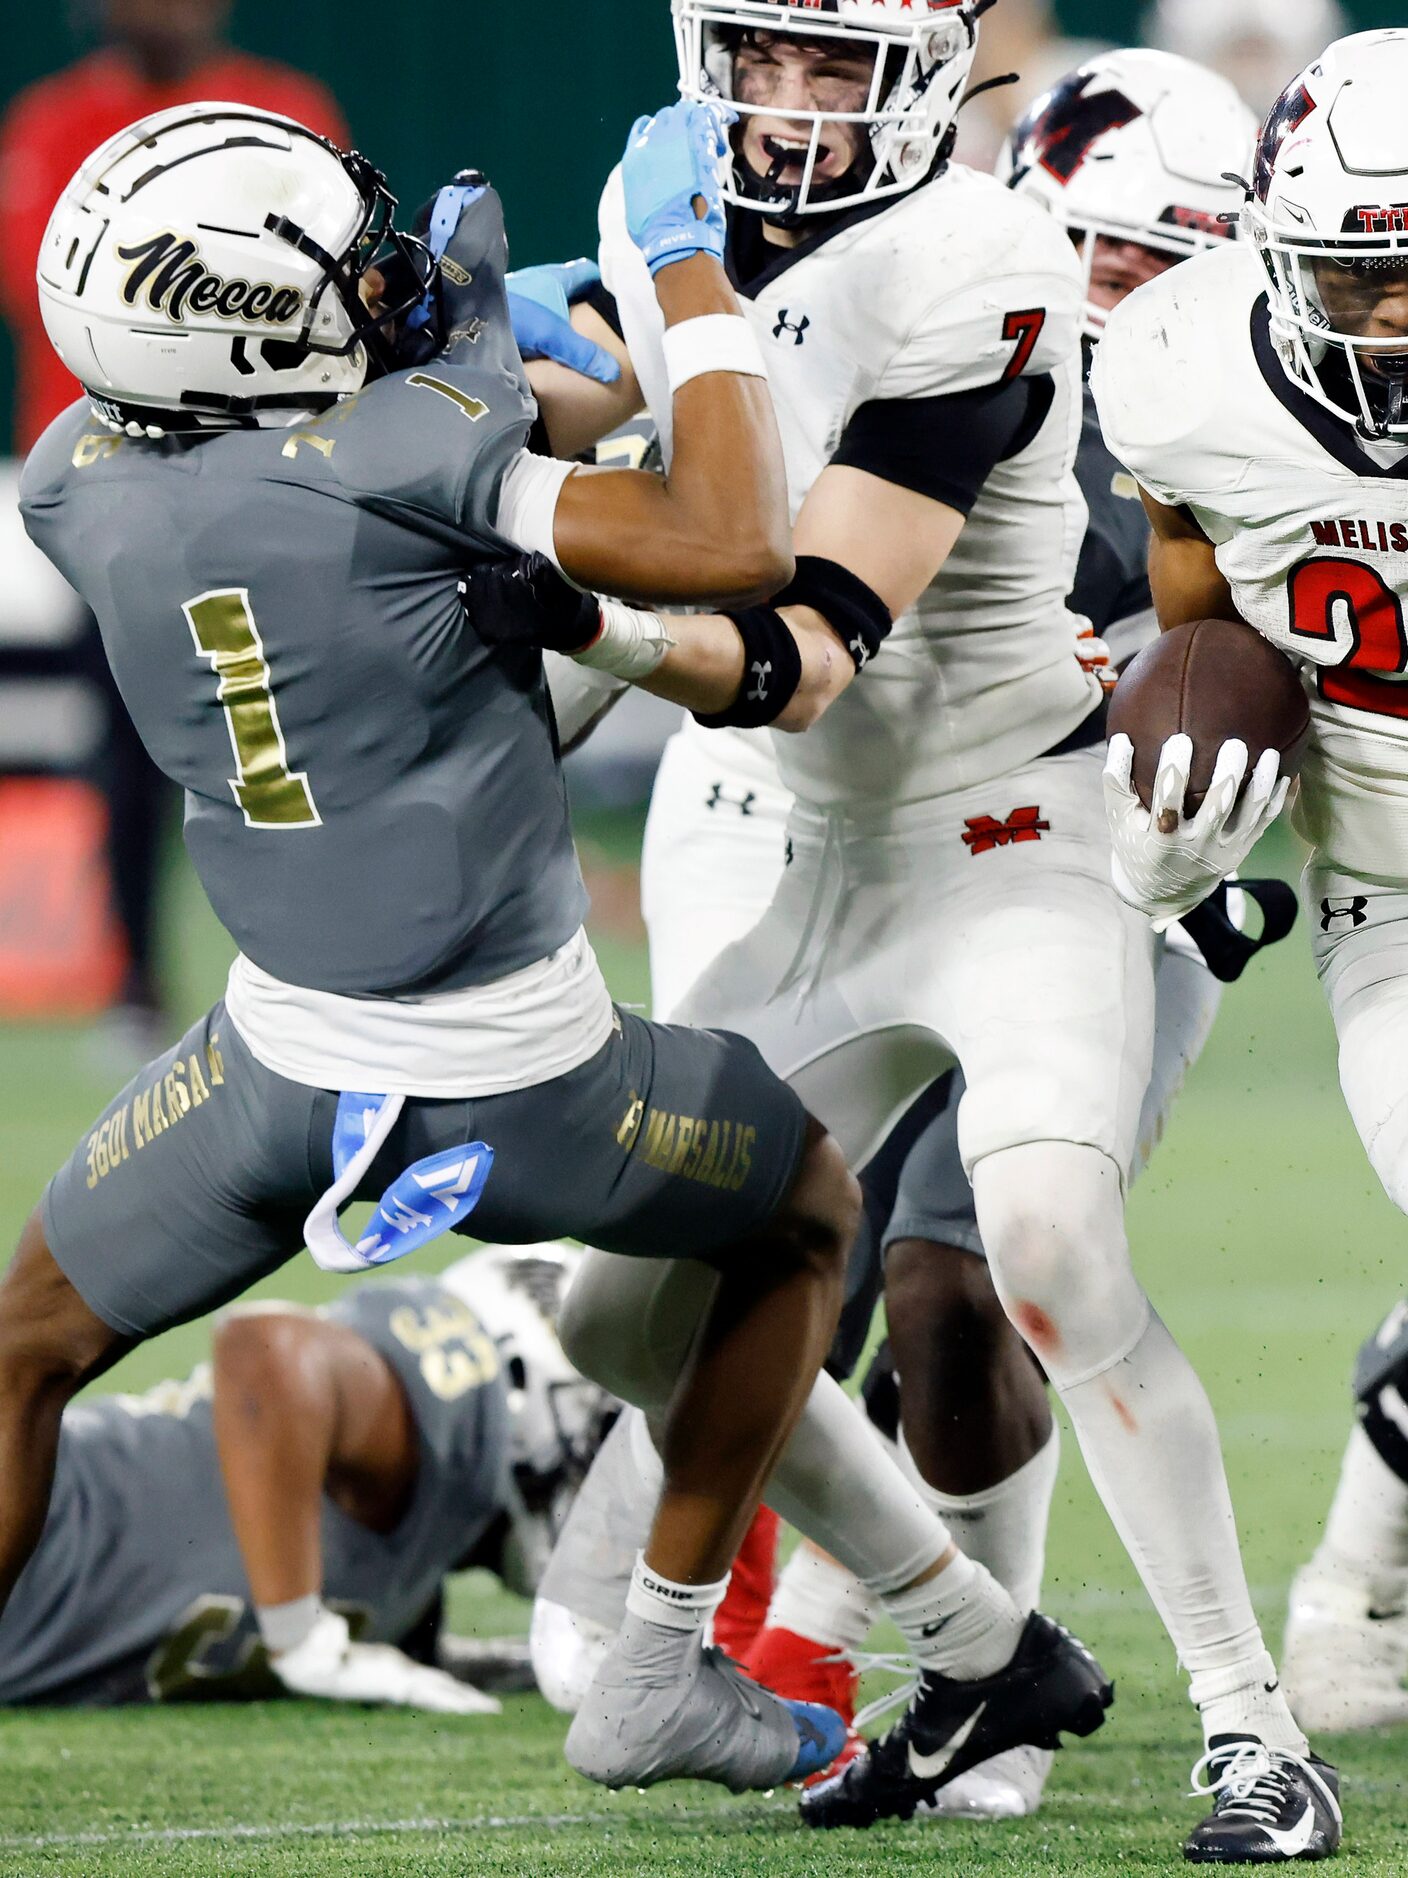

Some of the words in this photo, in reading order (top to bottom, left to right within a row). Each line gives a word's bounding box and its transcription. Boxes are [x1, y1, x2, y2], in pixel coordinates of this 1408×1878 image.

[115, 229, 304, 325] Mecca
[1000, 307, 1046, 383] 7
[405, 372, 490, 423] 1
[181, 588, 324, 830] 1
[86, 1102, 130, 1190] 3601
